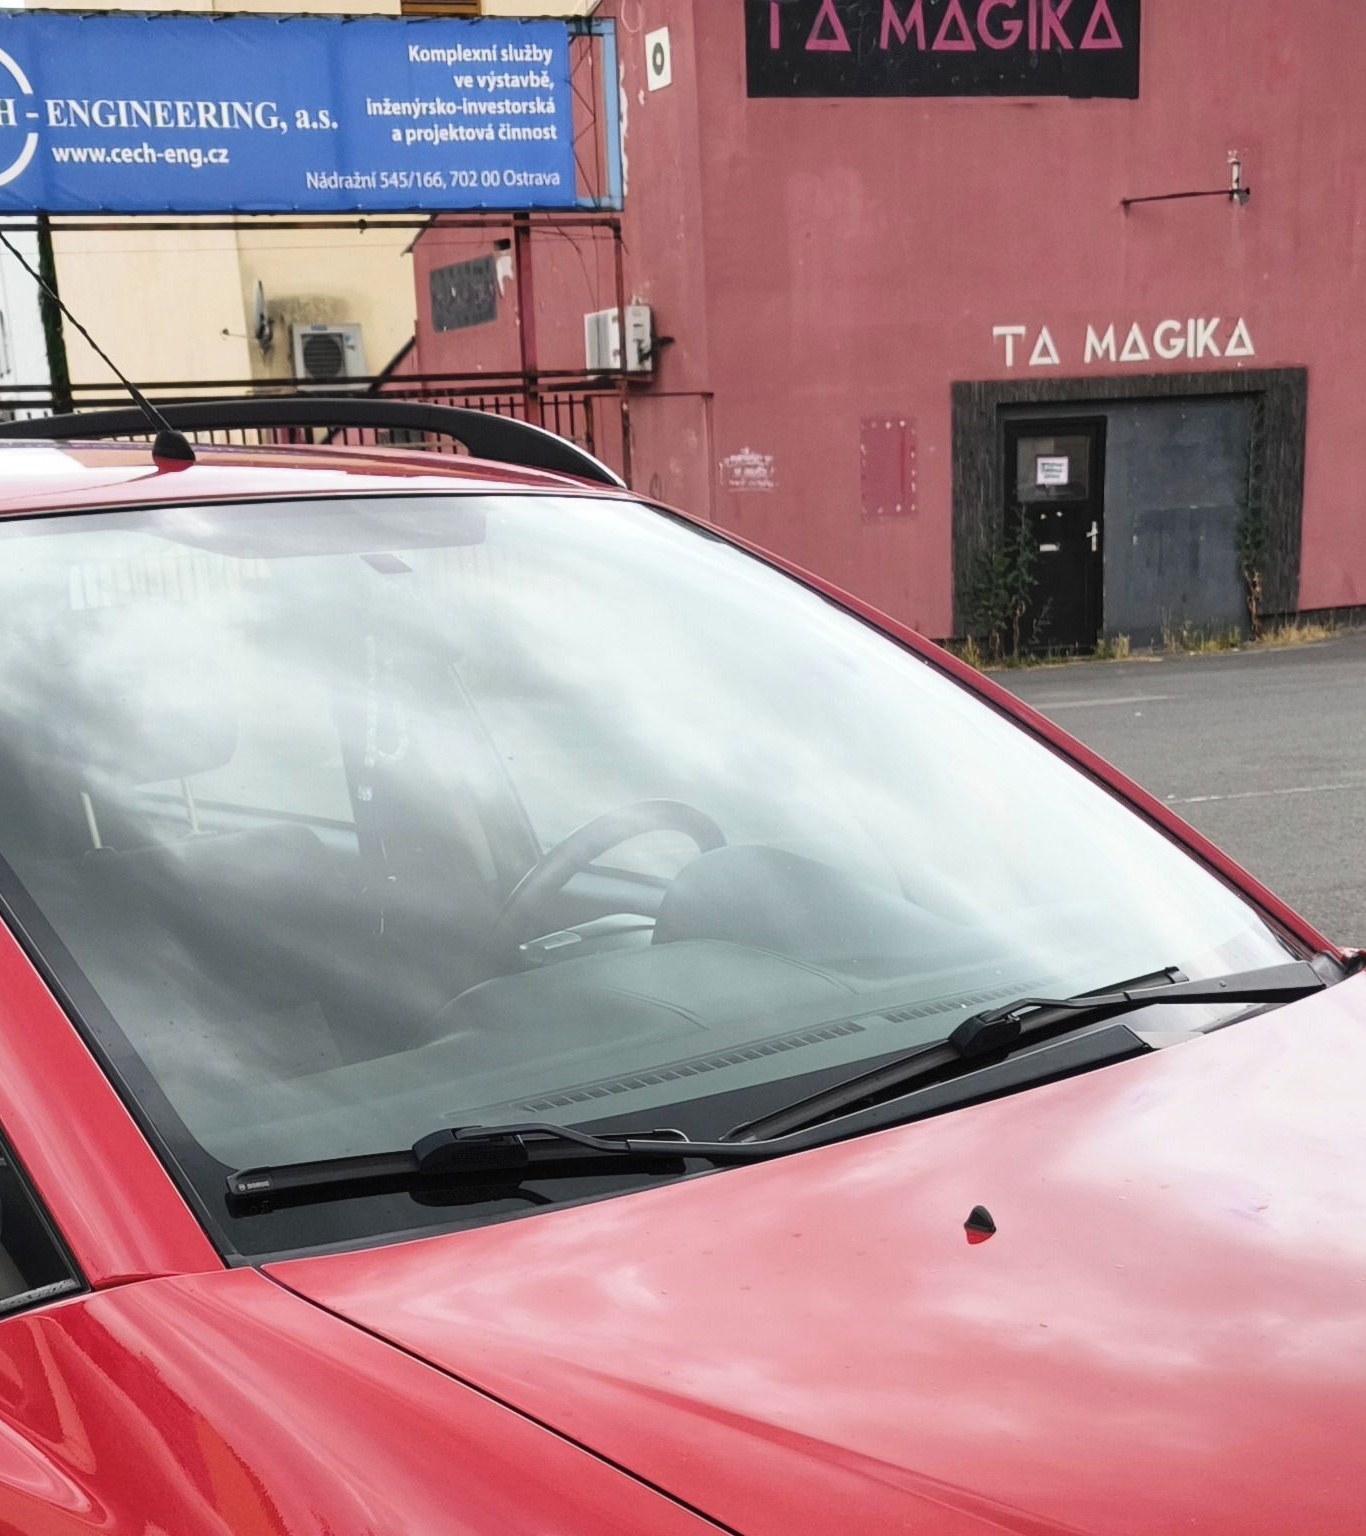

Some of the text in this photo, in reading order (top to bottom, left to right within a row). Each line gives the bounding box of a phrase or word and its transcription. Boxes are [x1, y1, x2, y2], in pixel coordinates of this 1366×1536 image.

[879, 0, 1124, 51] MAGIKA
[408, 43, 553, 66] Komplexní služby
[454, 70, 555, 93] ve výstavbě,
[46, 98, 289, 135] ENGINEERING,
[295, 107, 339, 130] a.s.
[366, 97, 556, 120] inženýrsko-investorská
[392, 123, 557, 145] a projektová činnost
[51, 142, 230, 168] www.cech-eng.cz
[306, 168, 561, 190] Nádražní 545/166, 702 00 Ostrava
[992, 316, 1256, 367] TA MAGIKA
